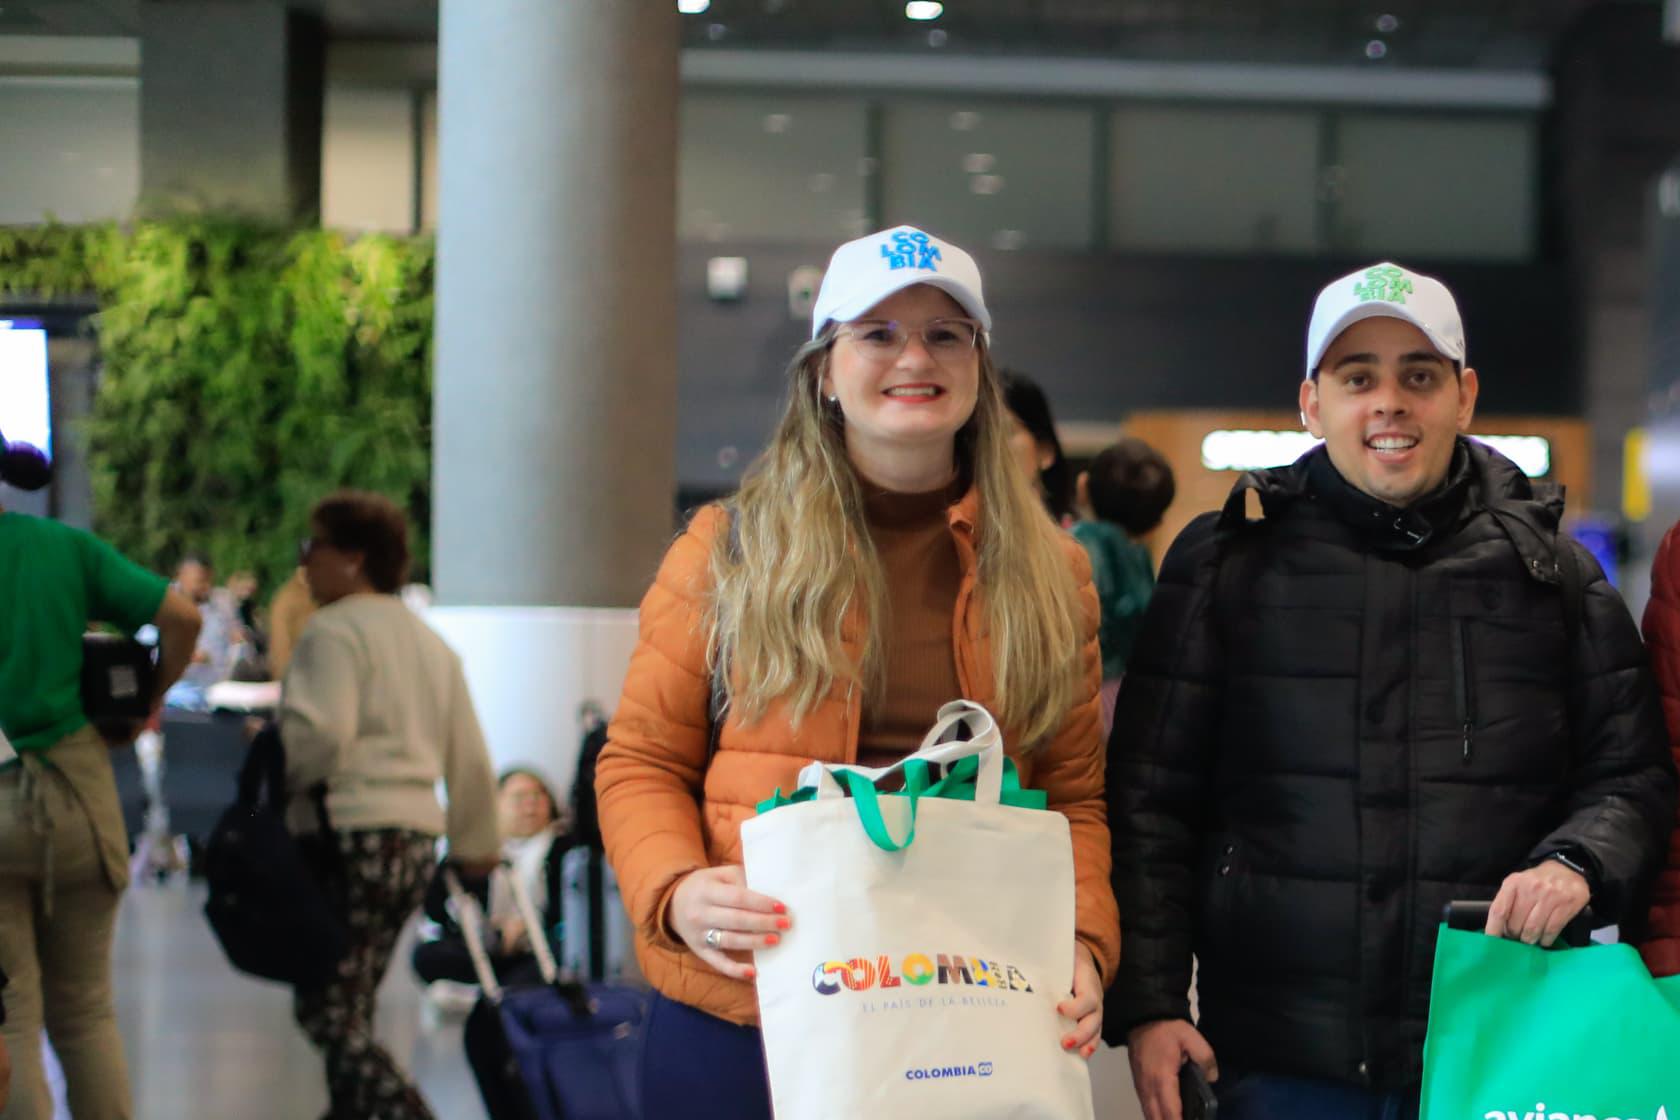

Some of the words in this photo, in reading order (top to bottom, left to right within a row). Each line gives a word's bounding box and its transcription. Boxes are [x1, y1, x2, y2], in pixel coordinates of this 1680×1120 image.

[892, 231, 929, 243] CO
[880, 242, 942, 262] LOM
[890, 253, 937, 272] BIA
[812, 953, 1034, 996] COLOMBIA
[905, 1065, 976, 1080] COLOMBIA
